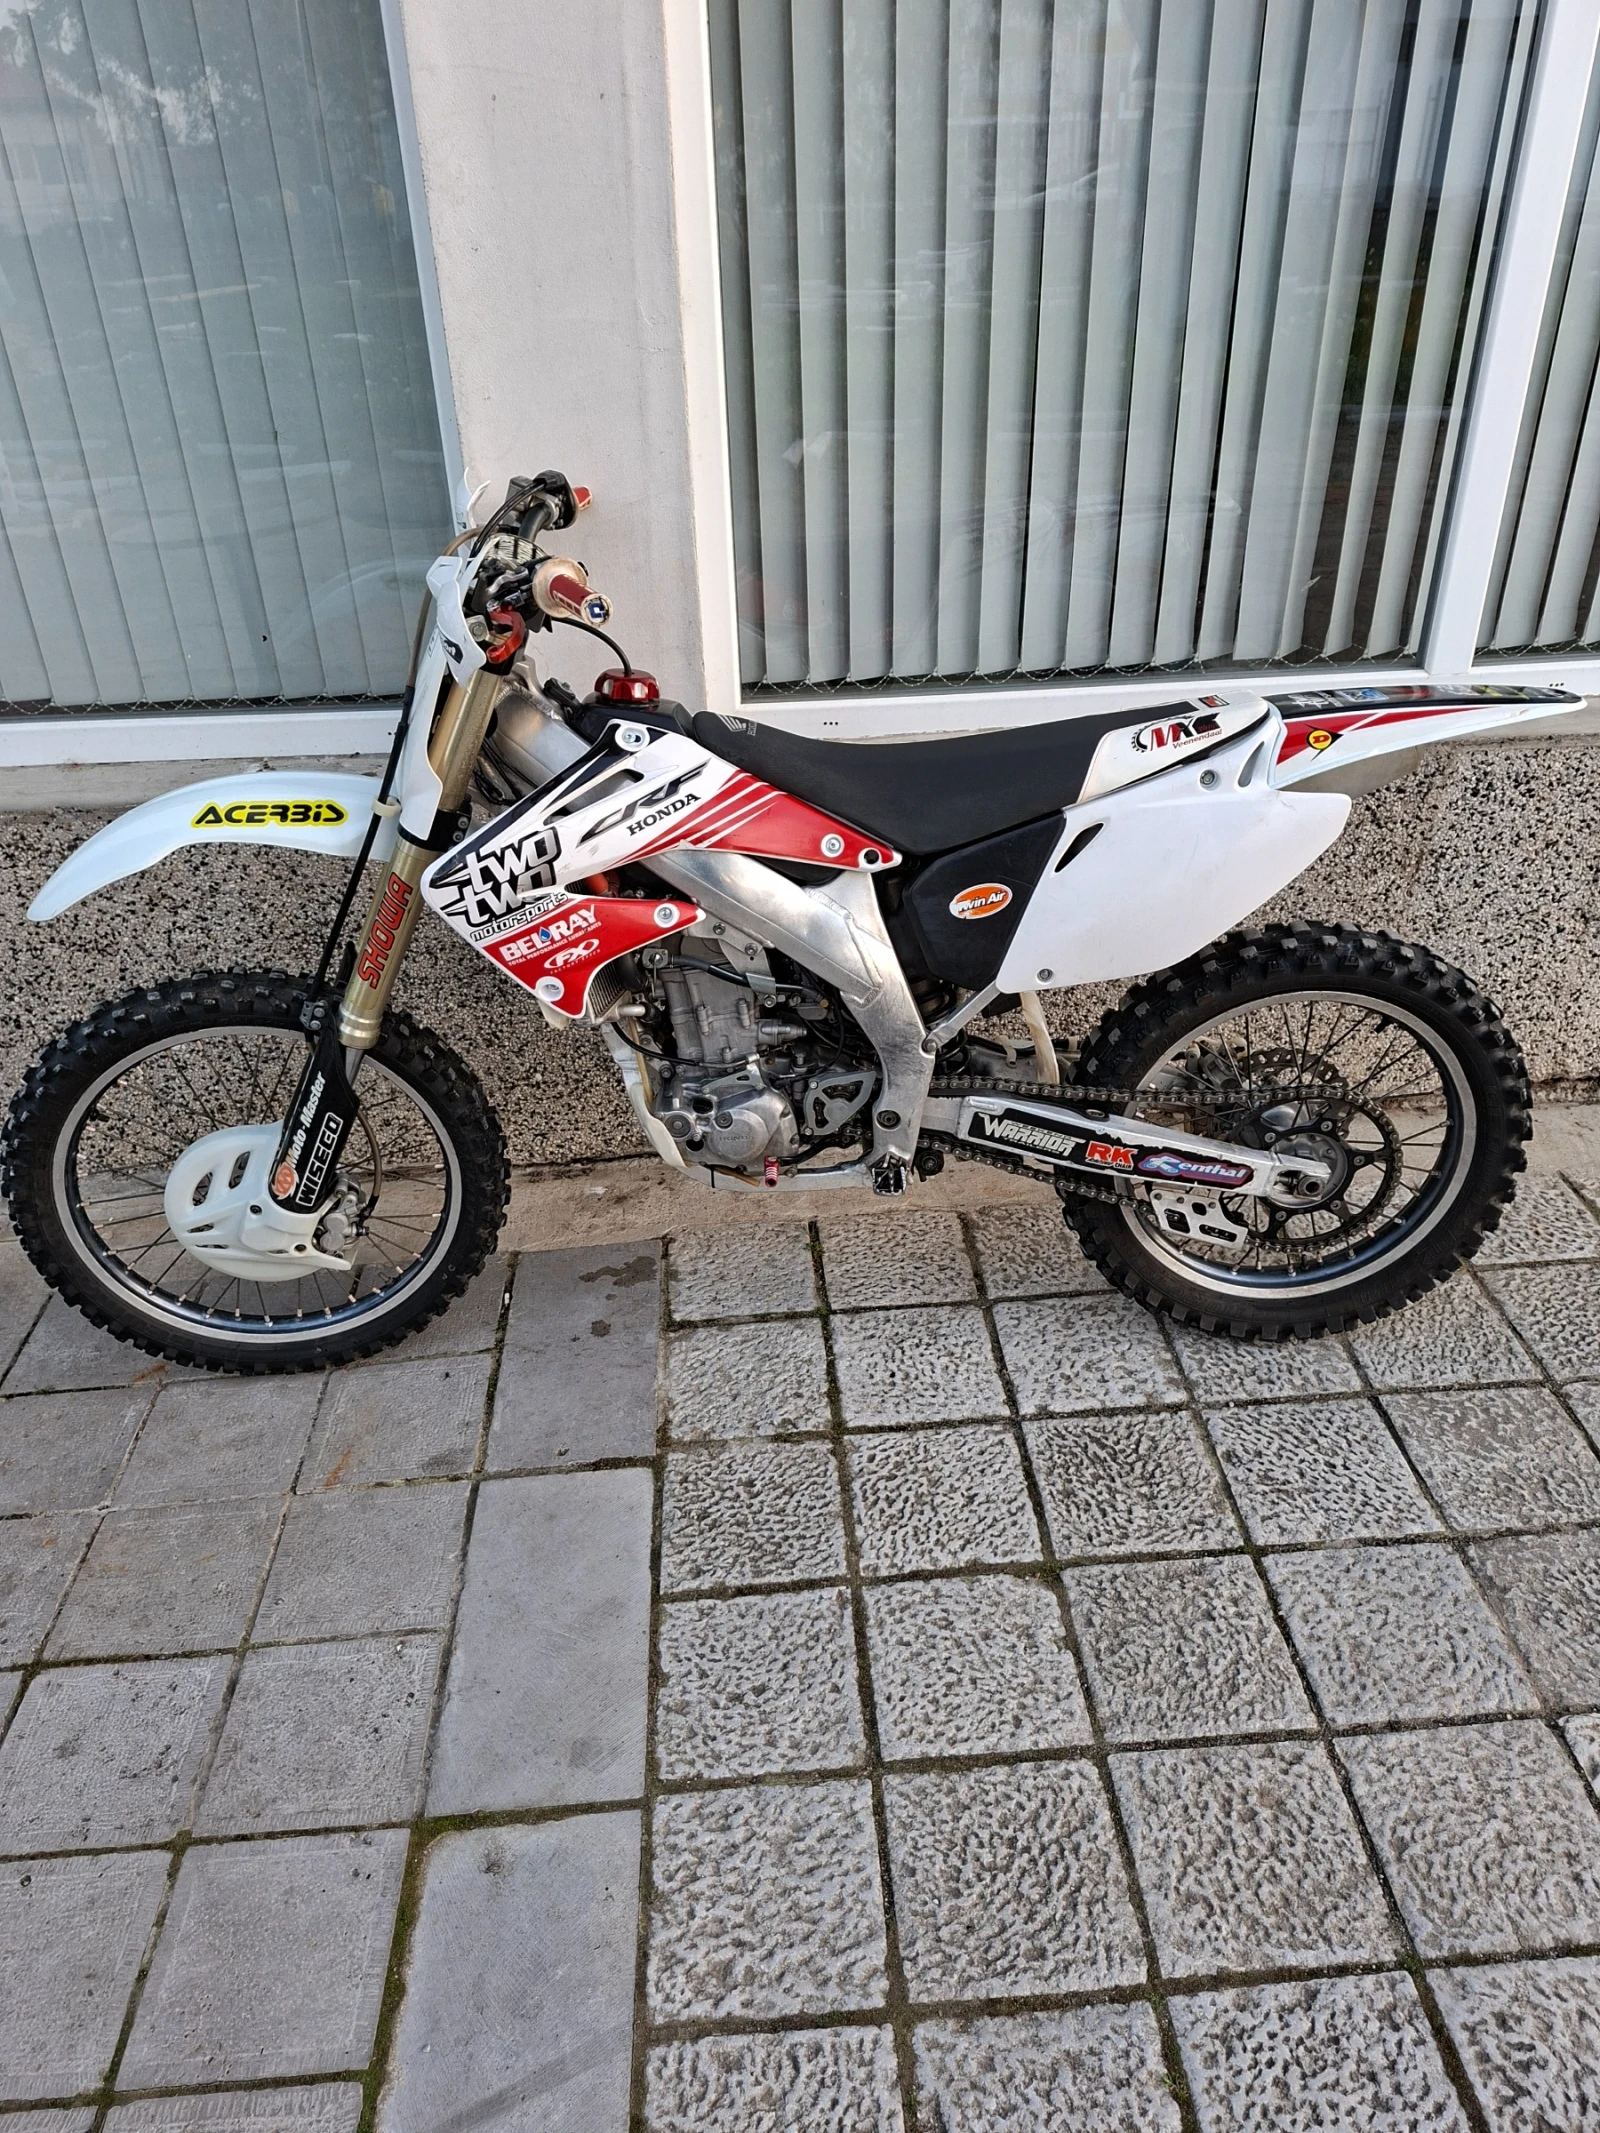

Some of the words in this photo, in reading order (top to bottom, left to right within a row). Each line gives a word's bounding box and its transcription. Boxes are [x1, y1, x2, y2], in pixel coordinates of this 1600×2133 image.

[1173, 729, 1222, 749] Veenendaal
[576, 758, 712, 849] CRF
[626, 793, 702, 836] HONDA
[470, 891, 569, 942] motorsports
[987, 891, 1006, 905] Air
[357, 871, 414, 990] SHOWA
[508, 957, 527, 967] TOTAL
[526, 939, 569, 960] PERFORMANCE
[978, 1113, 1086, 1157] WARRIOR
[1086, 1141, 1138, 1164] RK
[297, 1112, 343, 1206] WISECO
